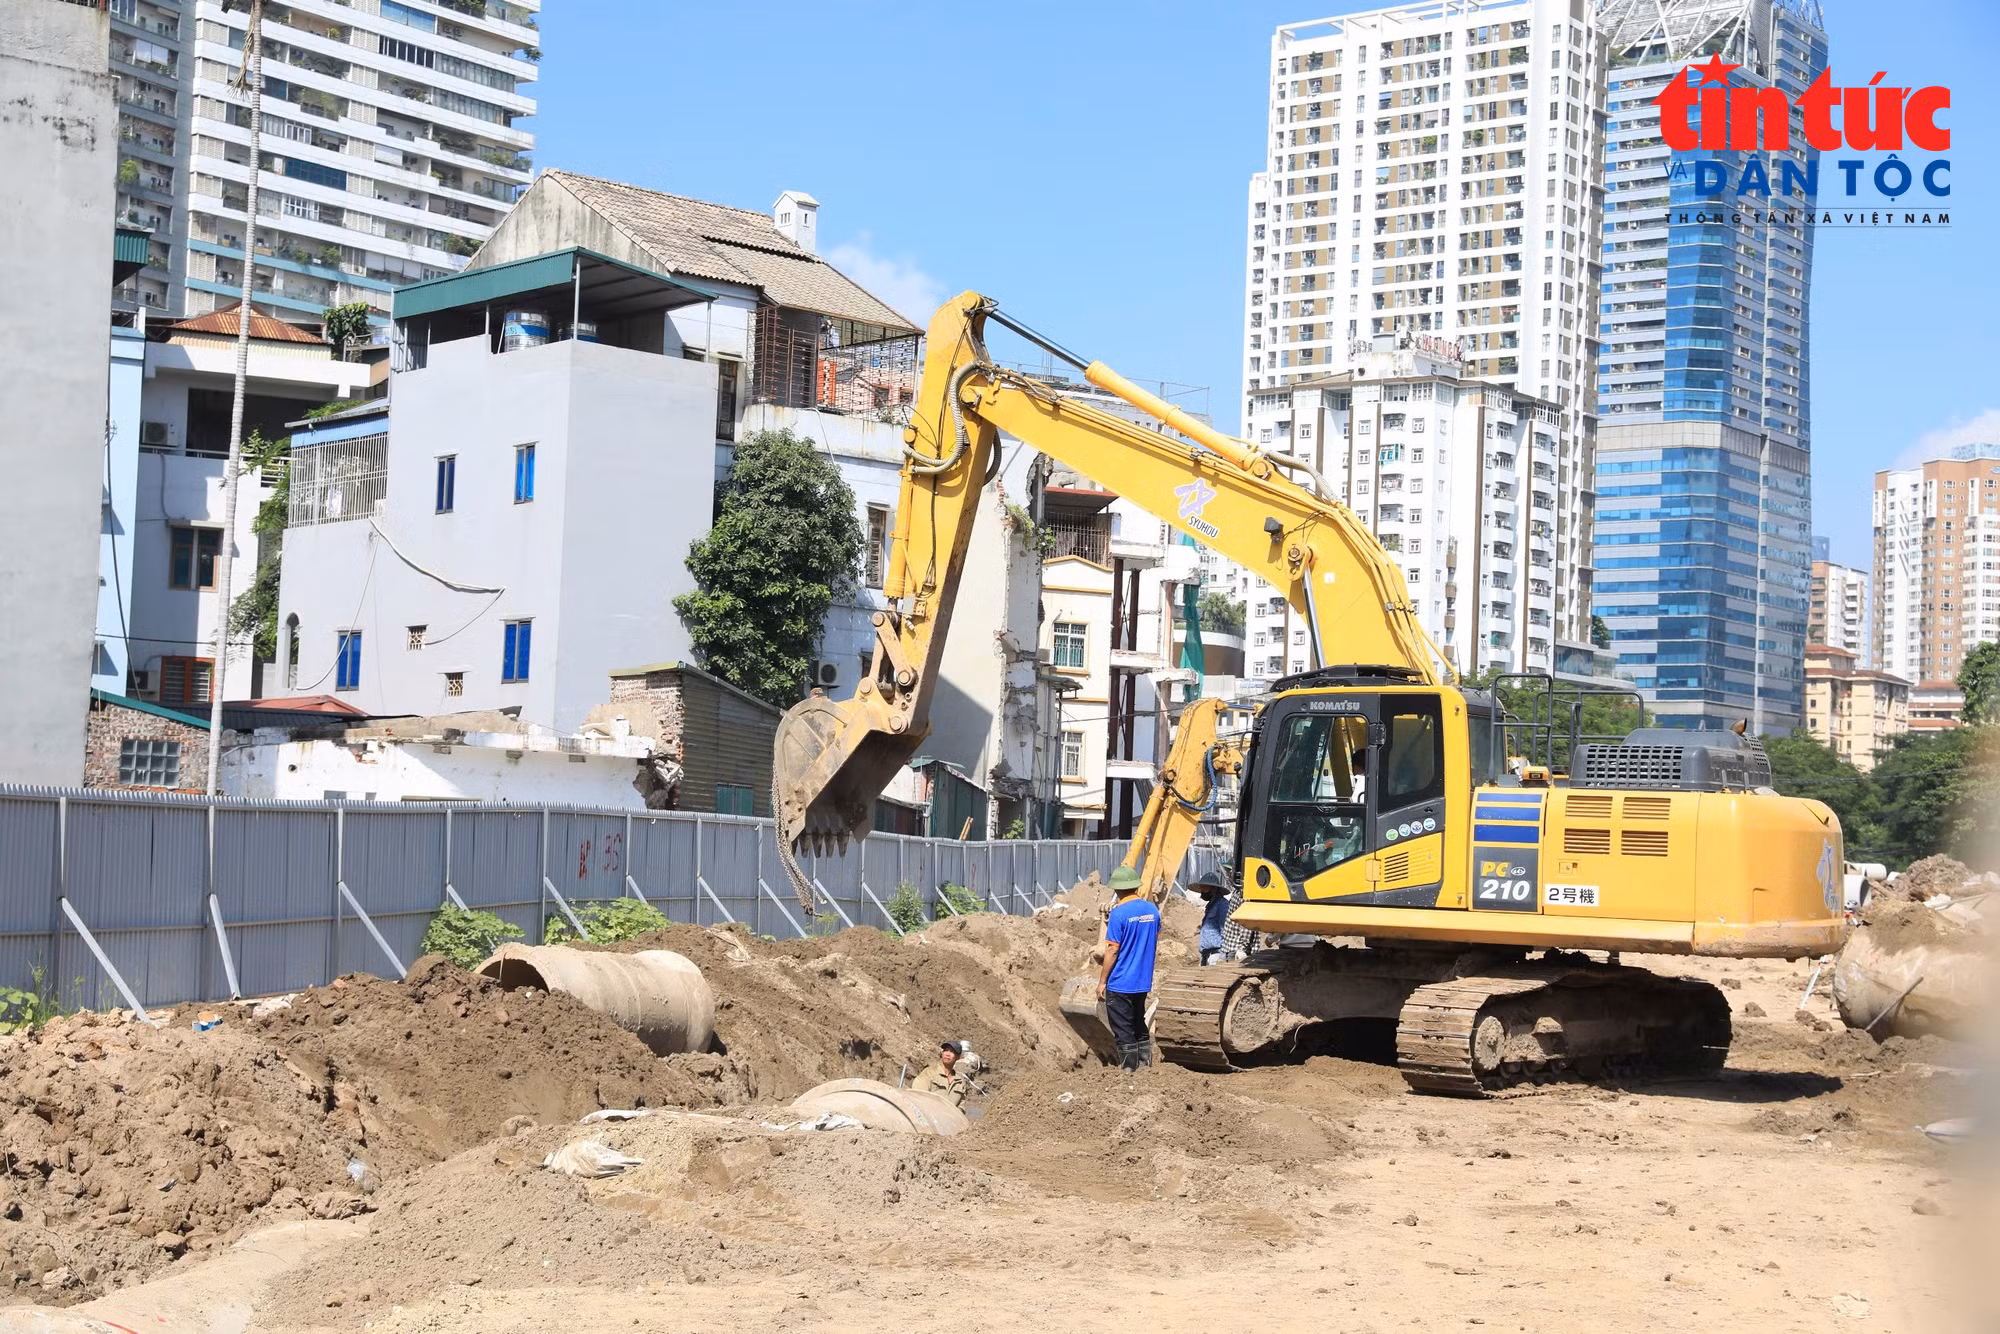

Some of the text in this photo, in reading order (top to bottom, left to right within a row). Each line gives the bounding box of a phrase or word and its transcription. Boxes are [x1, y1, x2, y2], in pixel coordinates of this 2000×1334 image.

[1188, 516, 1218, 538] SYUHOU
[1310, 700, 1360, 711] KOMATSU
[1481, 861, 1509, 877] PC
[1480, 879, 1530, 901] 210
[1549, 888, 1595, 904] 2号機
